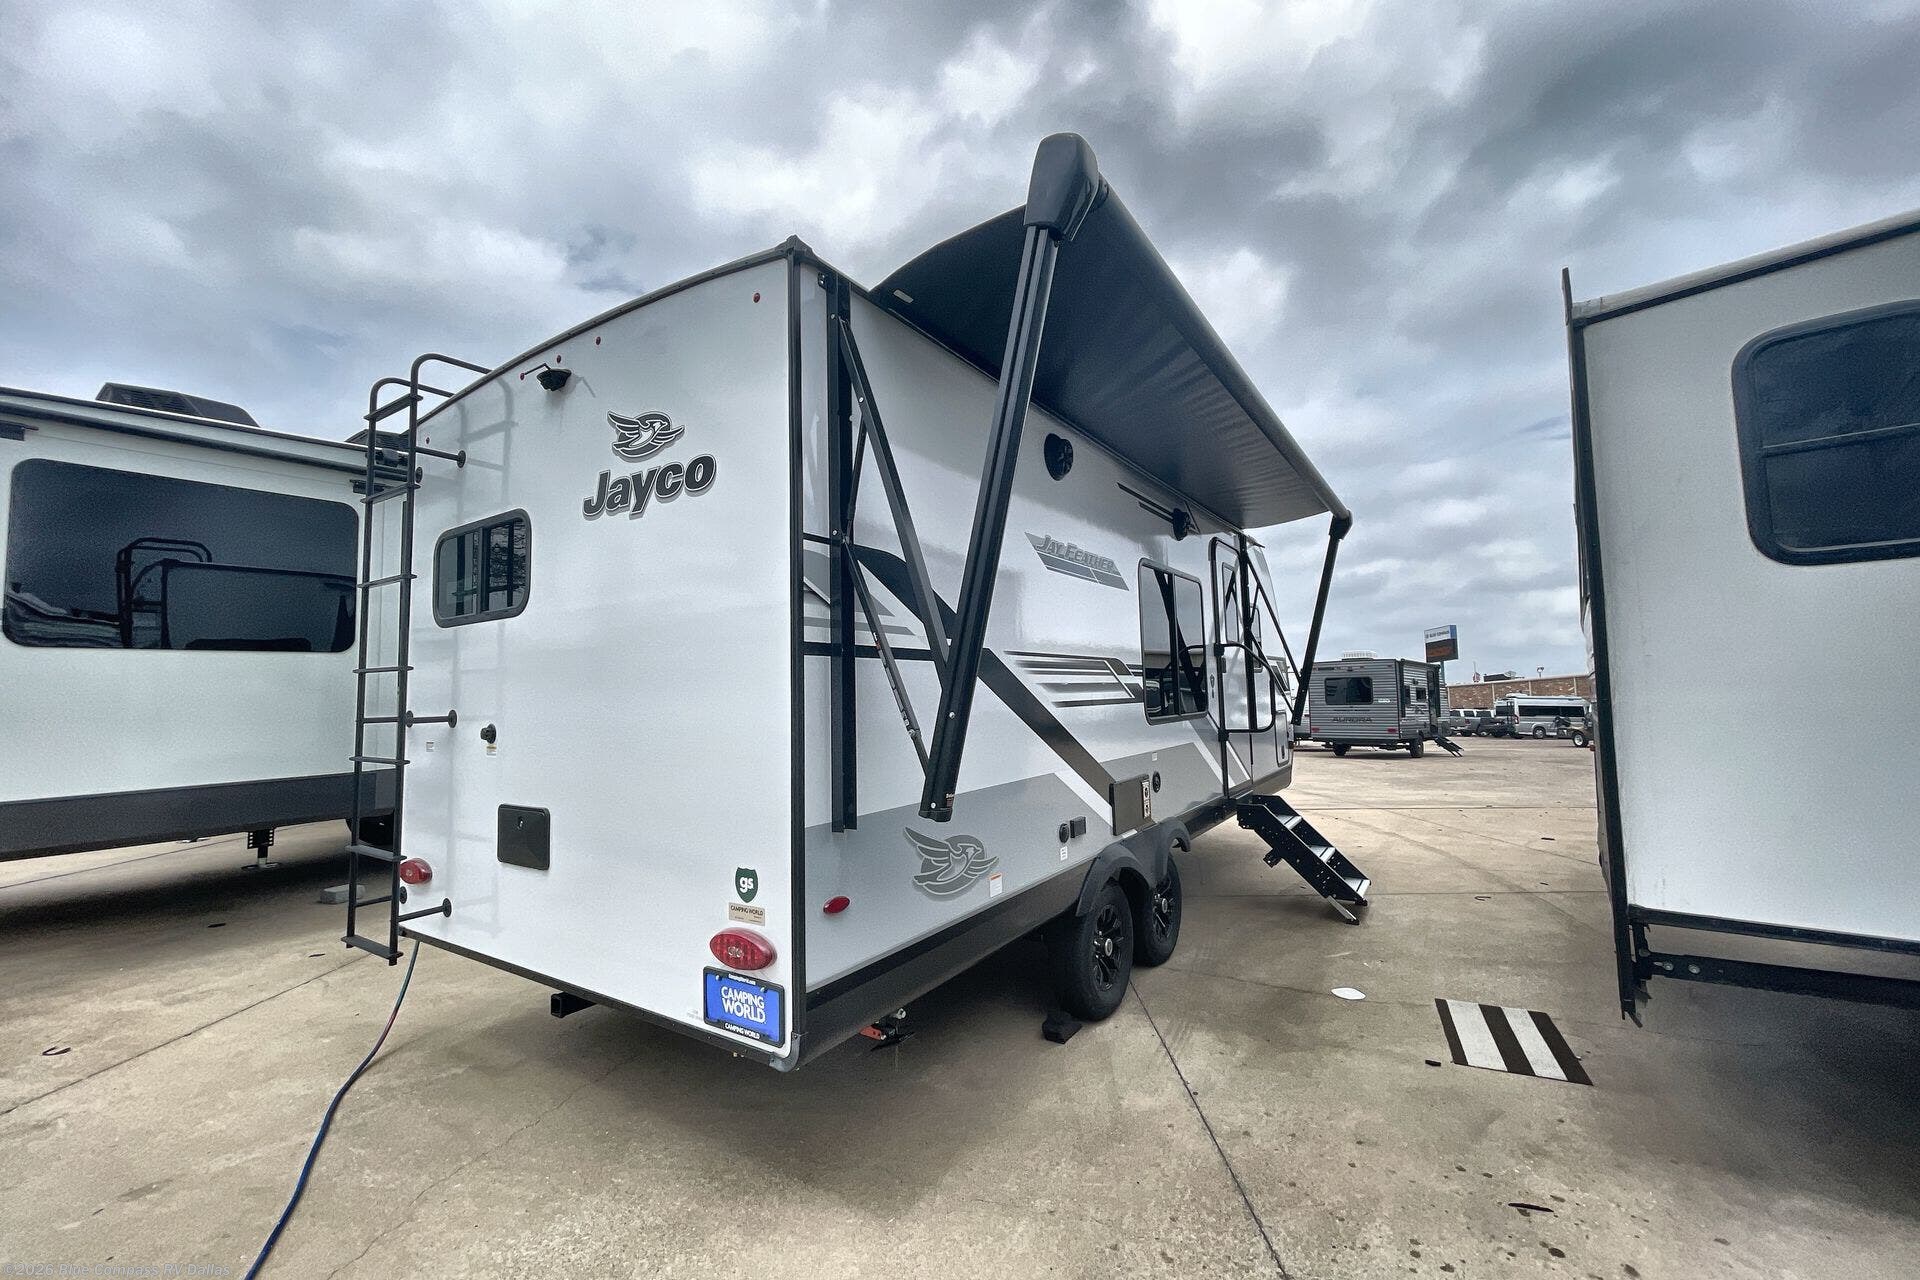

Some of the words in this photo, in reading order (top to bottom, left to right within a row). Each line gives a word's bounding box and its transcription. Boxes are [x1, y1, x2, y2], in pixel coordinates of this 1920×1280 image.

[582, 454, 717, 519] Jayco
[739, 876, 754, 893] gs
[730, 905, 748, 913] CAMPING
[749, 908, 763, 916] WORLD
[721, 986, 765, 1009] CAMPING
[722, 998, 766, 1023] WORLD
[725, 1023, 744, 1034] CAMPING
[744, 1028, 760, 1039] WORLD
